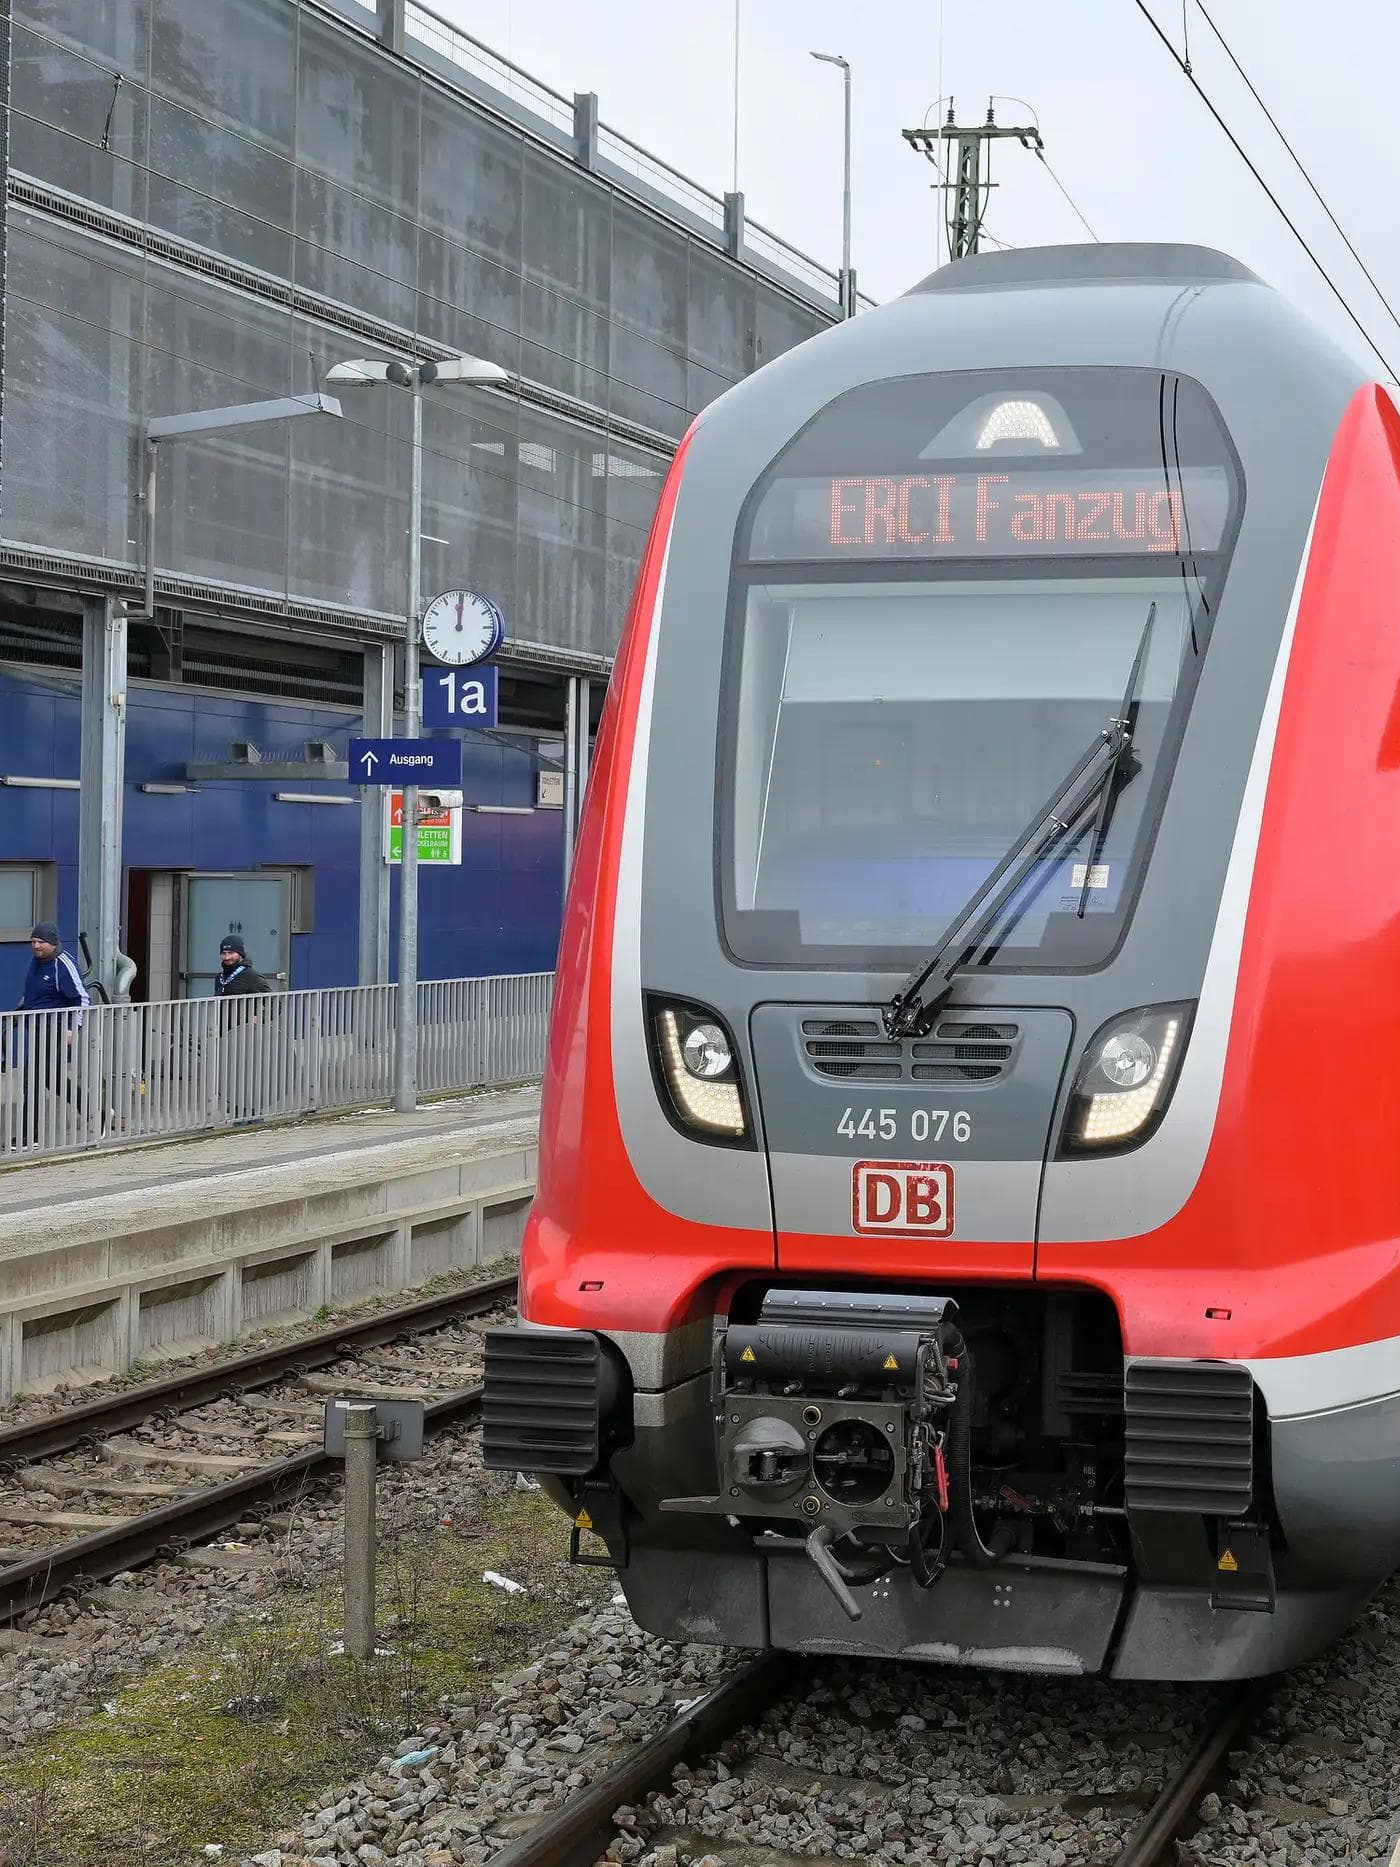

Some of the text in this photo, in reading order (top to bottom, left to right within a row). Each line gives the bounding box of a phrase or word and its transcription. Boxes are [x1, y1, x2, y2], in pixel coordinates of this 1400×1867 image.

[830, 475, 957, 544] ERCI
[439, 672, 487, 714] 1a
[390, 753, 434, 767] Ausgang
[836, 1107, 972, 1143] 445 076
[865, 1172, 943, 1226] DB
